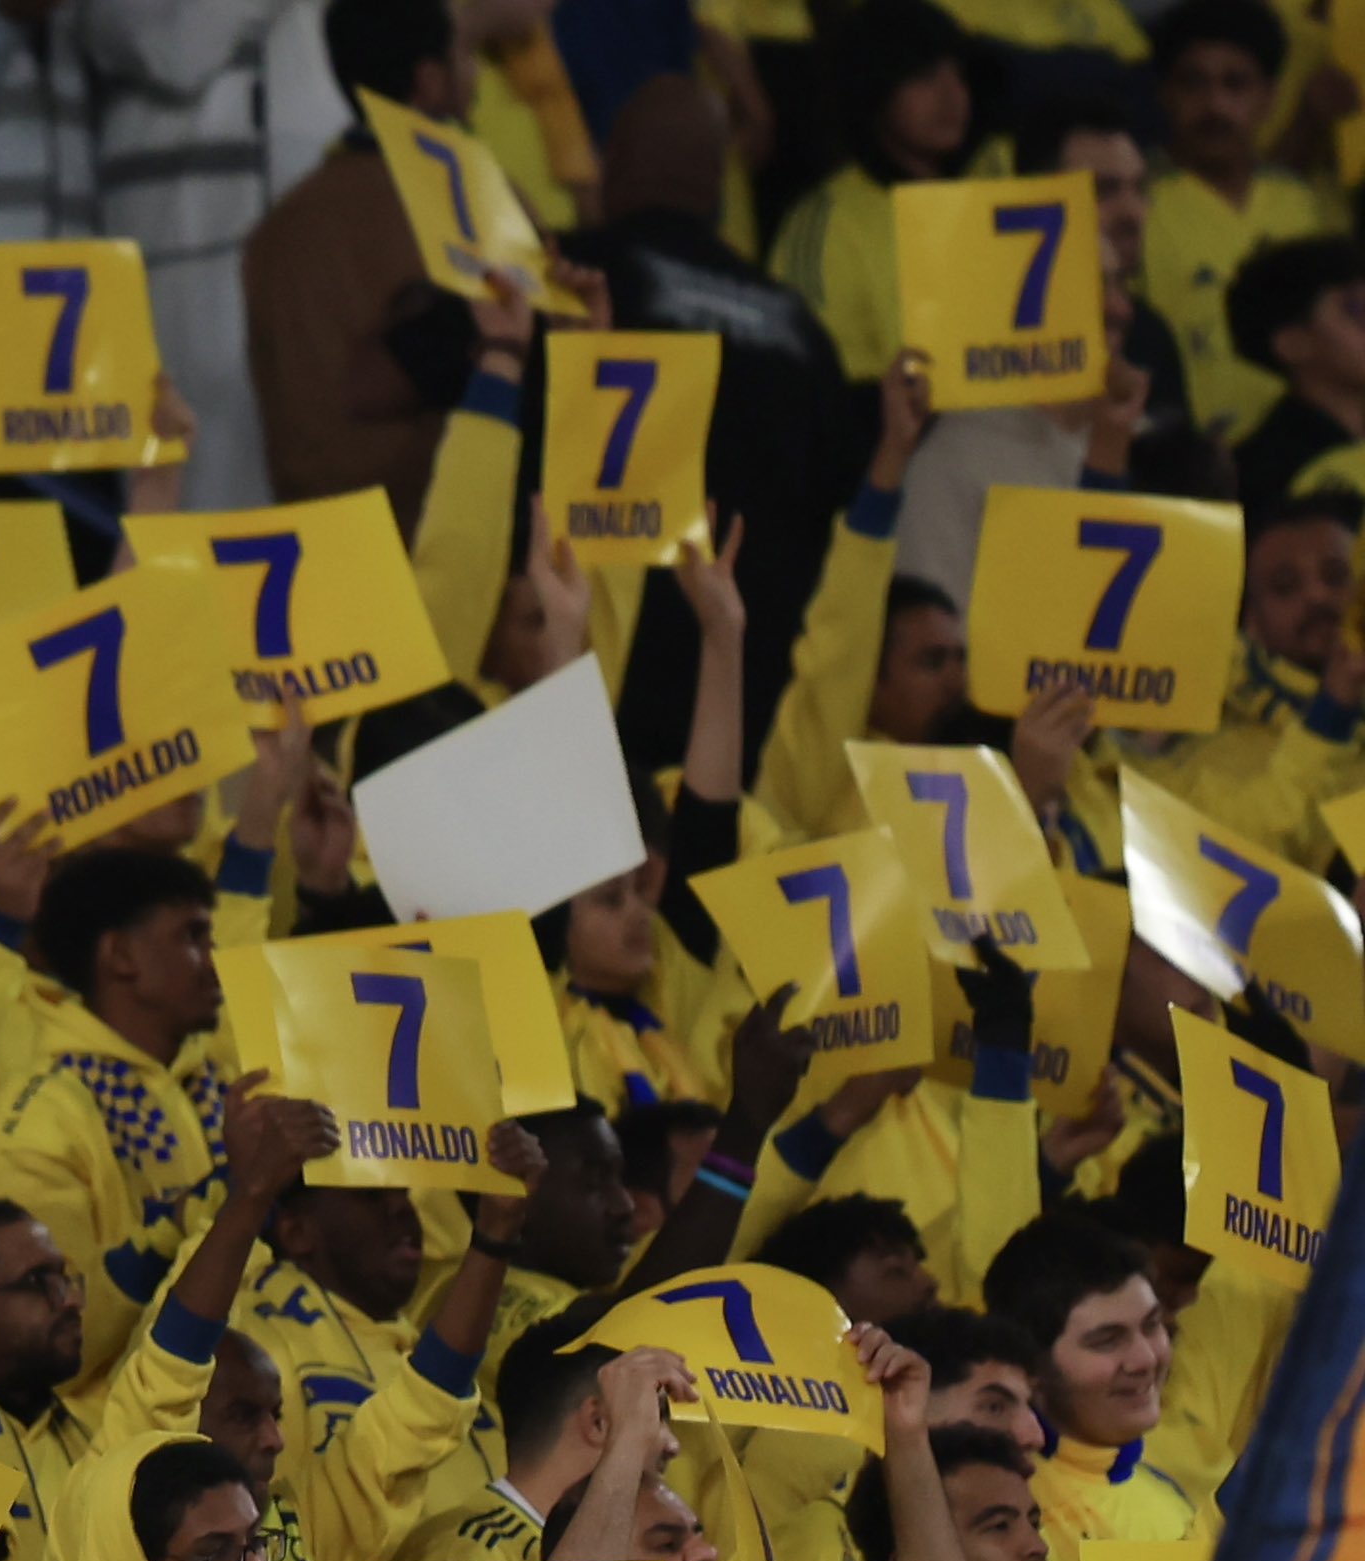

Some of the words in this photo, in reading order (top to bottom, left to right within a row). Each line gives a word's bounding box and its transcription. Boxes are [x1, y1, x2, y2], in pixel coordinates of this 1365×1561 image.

[417, 134, 475, 241] 7
[997, 205, 1065, 328] 7
[23, 268, 89, 393] 7
[2, 405, 131, 443] RONALDO
[598, 361, 657, 488] 7
[213, 534, 301, 658] 7
[1081, 521, 1162, 650] 7
[32, 608, 126, 756] 7
[49, 730, 199, 823] RONALDO
[907, 771, 975, 902] 7
[780, 864, 861, 996] 7
[1200, 835, 1280, 955] 7
[353, 973, 427, 1109] 7
[348, 1121, 477, 1168] RONALDO
[1234, 1061, 1285, 1200] 7
[658, 1281, 773, 1364] 7
[705, 1367, 849, 1415] RONALDO
